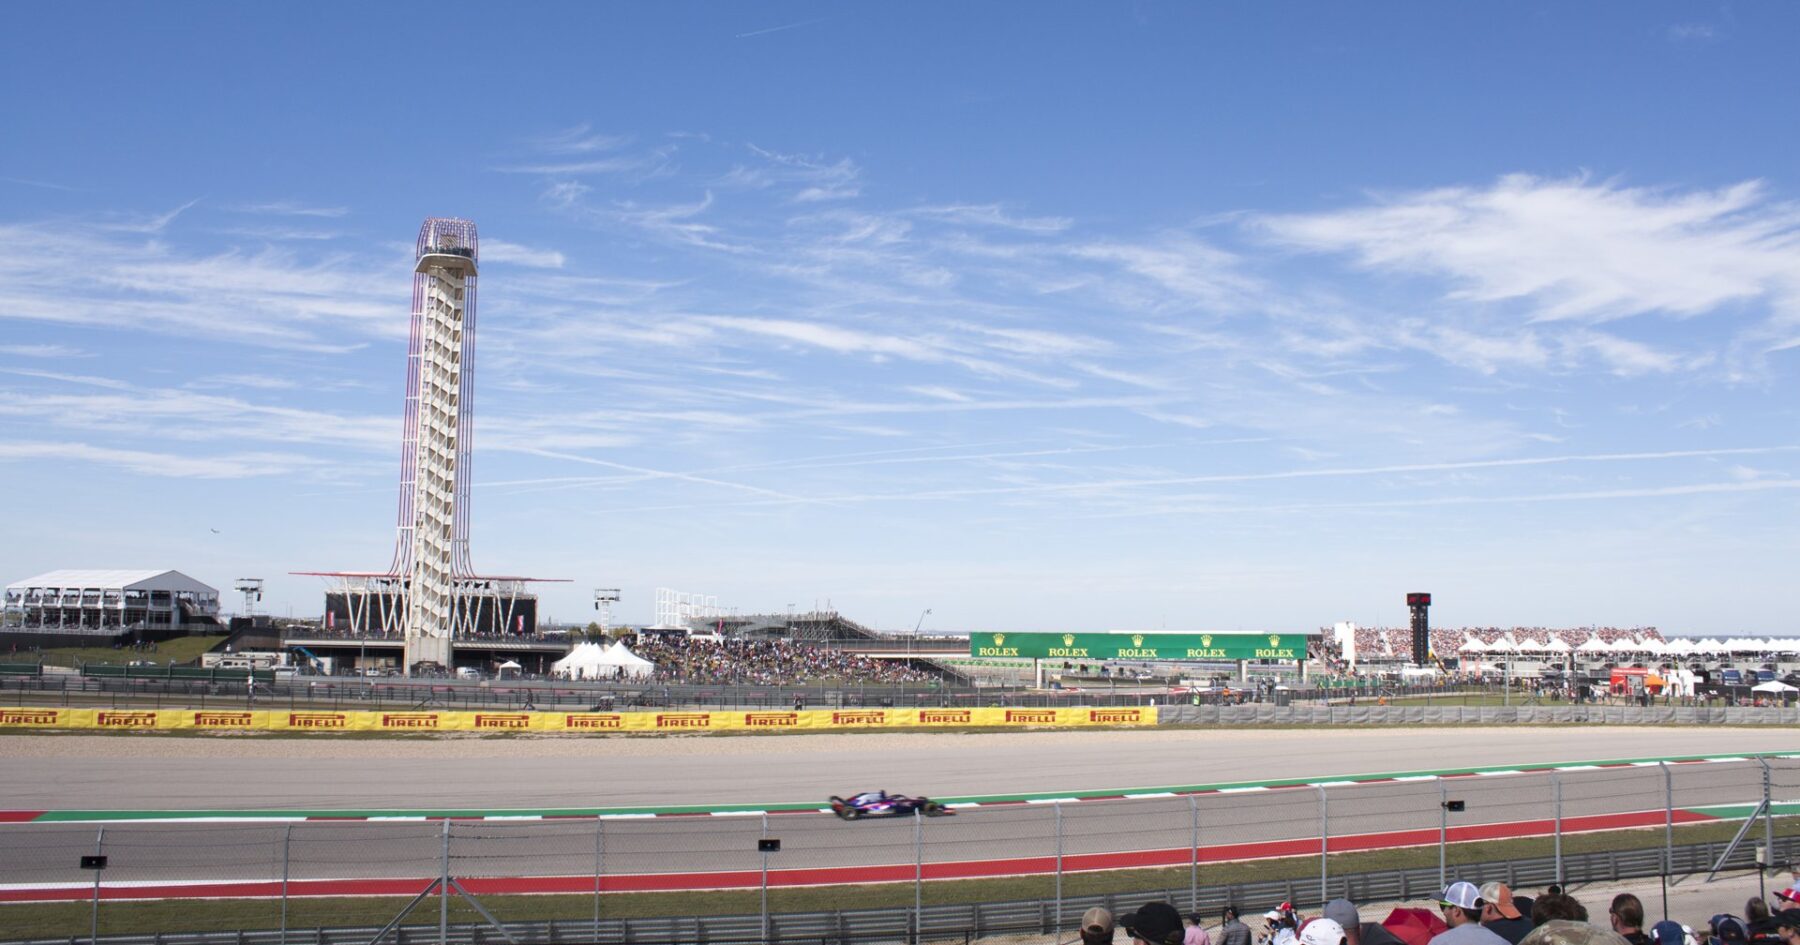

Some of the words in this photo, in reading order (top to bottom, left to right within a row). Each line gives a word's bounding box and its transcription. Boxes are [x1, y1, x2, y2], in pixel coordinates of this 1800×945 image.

[979, 648, 1018, 656] ROLEX
[1049, 648, 1088, 657] ROLEX
[1118, 649, 1157, 657] ROLEX
[1187, 649, 1226, 657] ROLEX
[1255, 649, 1293, 657] ROLEX
[98, 712, 156, 726] PIRELLI
[195, 713, 251, 726] PIRELLI
[289, 714, 345, 727] PIRELLI
[383, 714, 438, 727] PIRELLI
[475, 715, 529, 728] PIRELLI
[567, 715, 620, 728] PIRELLI
[657, 714, 709, 727] PIRELLI
[746, 713, 797, 726] PIRELLI
[833, 712, 884, 724] PIRELLI
[920, 711, 970, 723] PIRELLI
[1006, 710, 1056, 722] PIRELLI
[1090, 710, 1140, 722] PIRELLI
